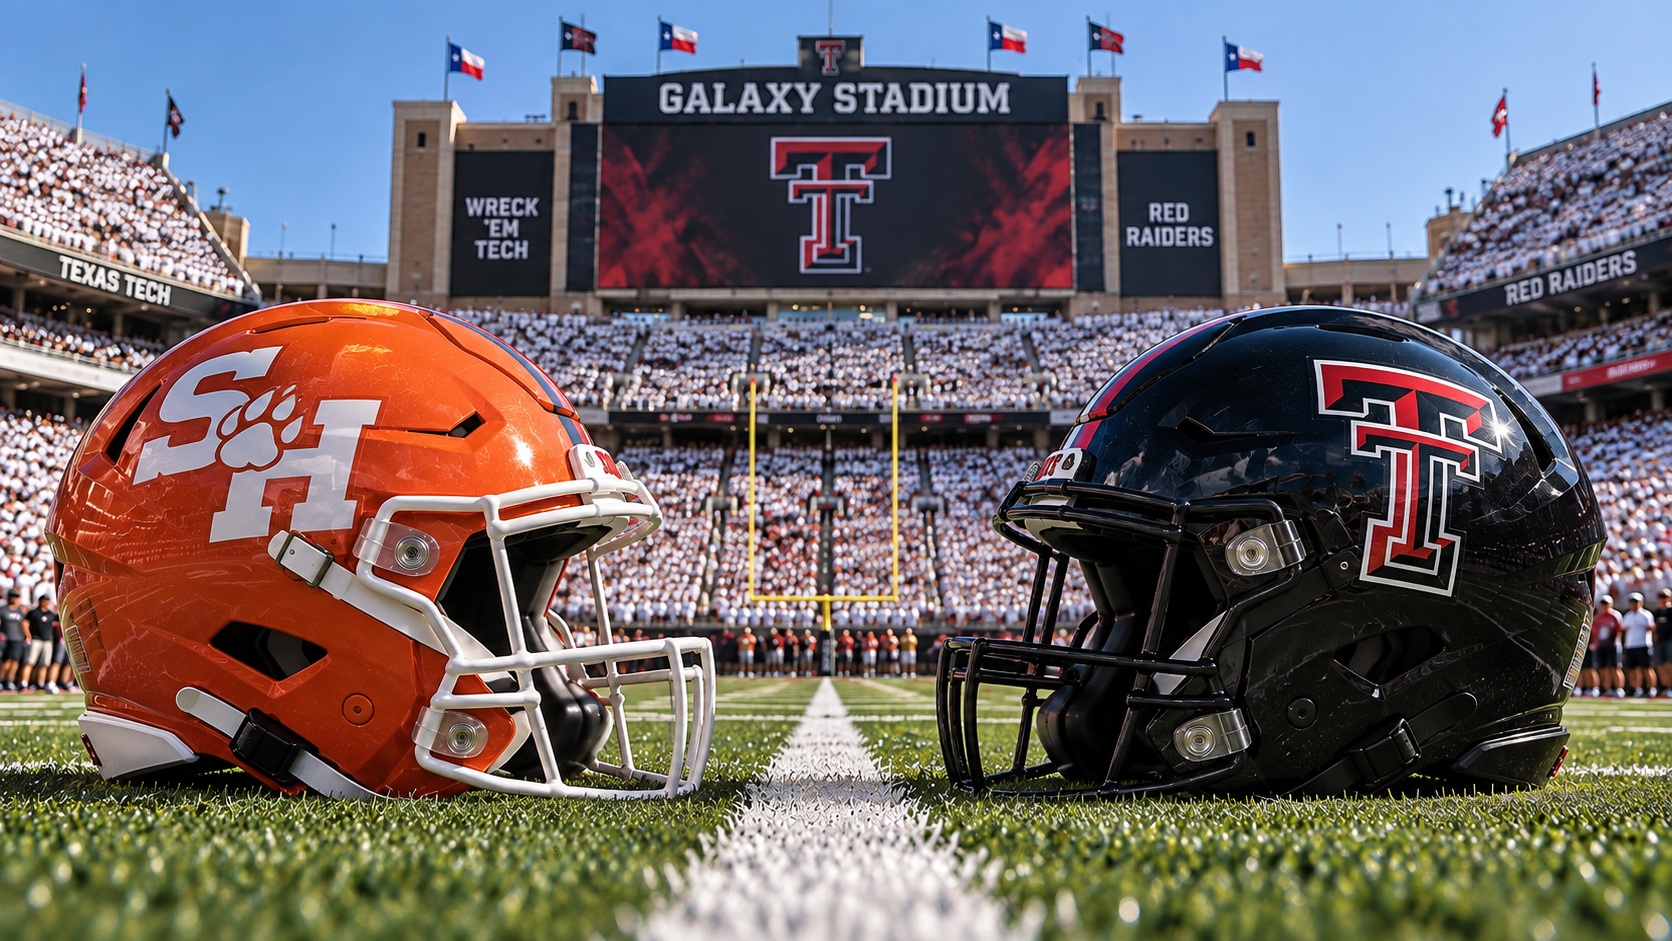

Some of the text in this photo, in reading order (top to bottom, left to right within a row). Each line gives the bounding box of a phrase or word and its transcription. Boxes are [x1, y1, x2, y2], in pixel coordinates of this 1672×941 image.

[659, 82, 1011, 114] GALAXY STADIUM
[465, 197, 540, 217] WRECK
[1148, 202, 1190, 223] RED
[483, 218, 520, 238] 'EM
[1126, 226, 1214, 247] RAIDERS
[474, 239, 529, 260] TECH
[58, 254, 172, 306] TEXAS TECH
[1504, 250, 1638, 306] RED RAIDERS
